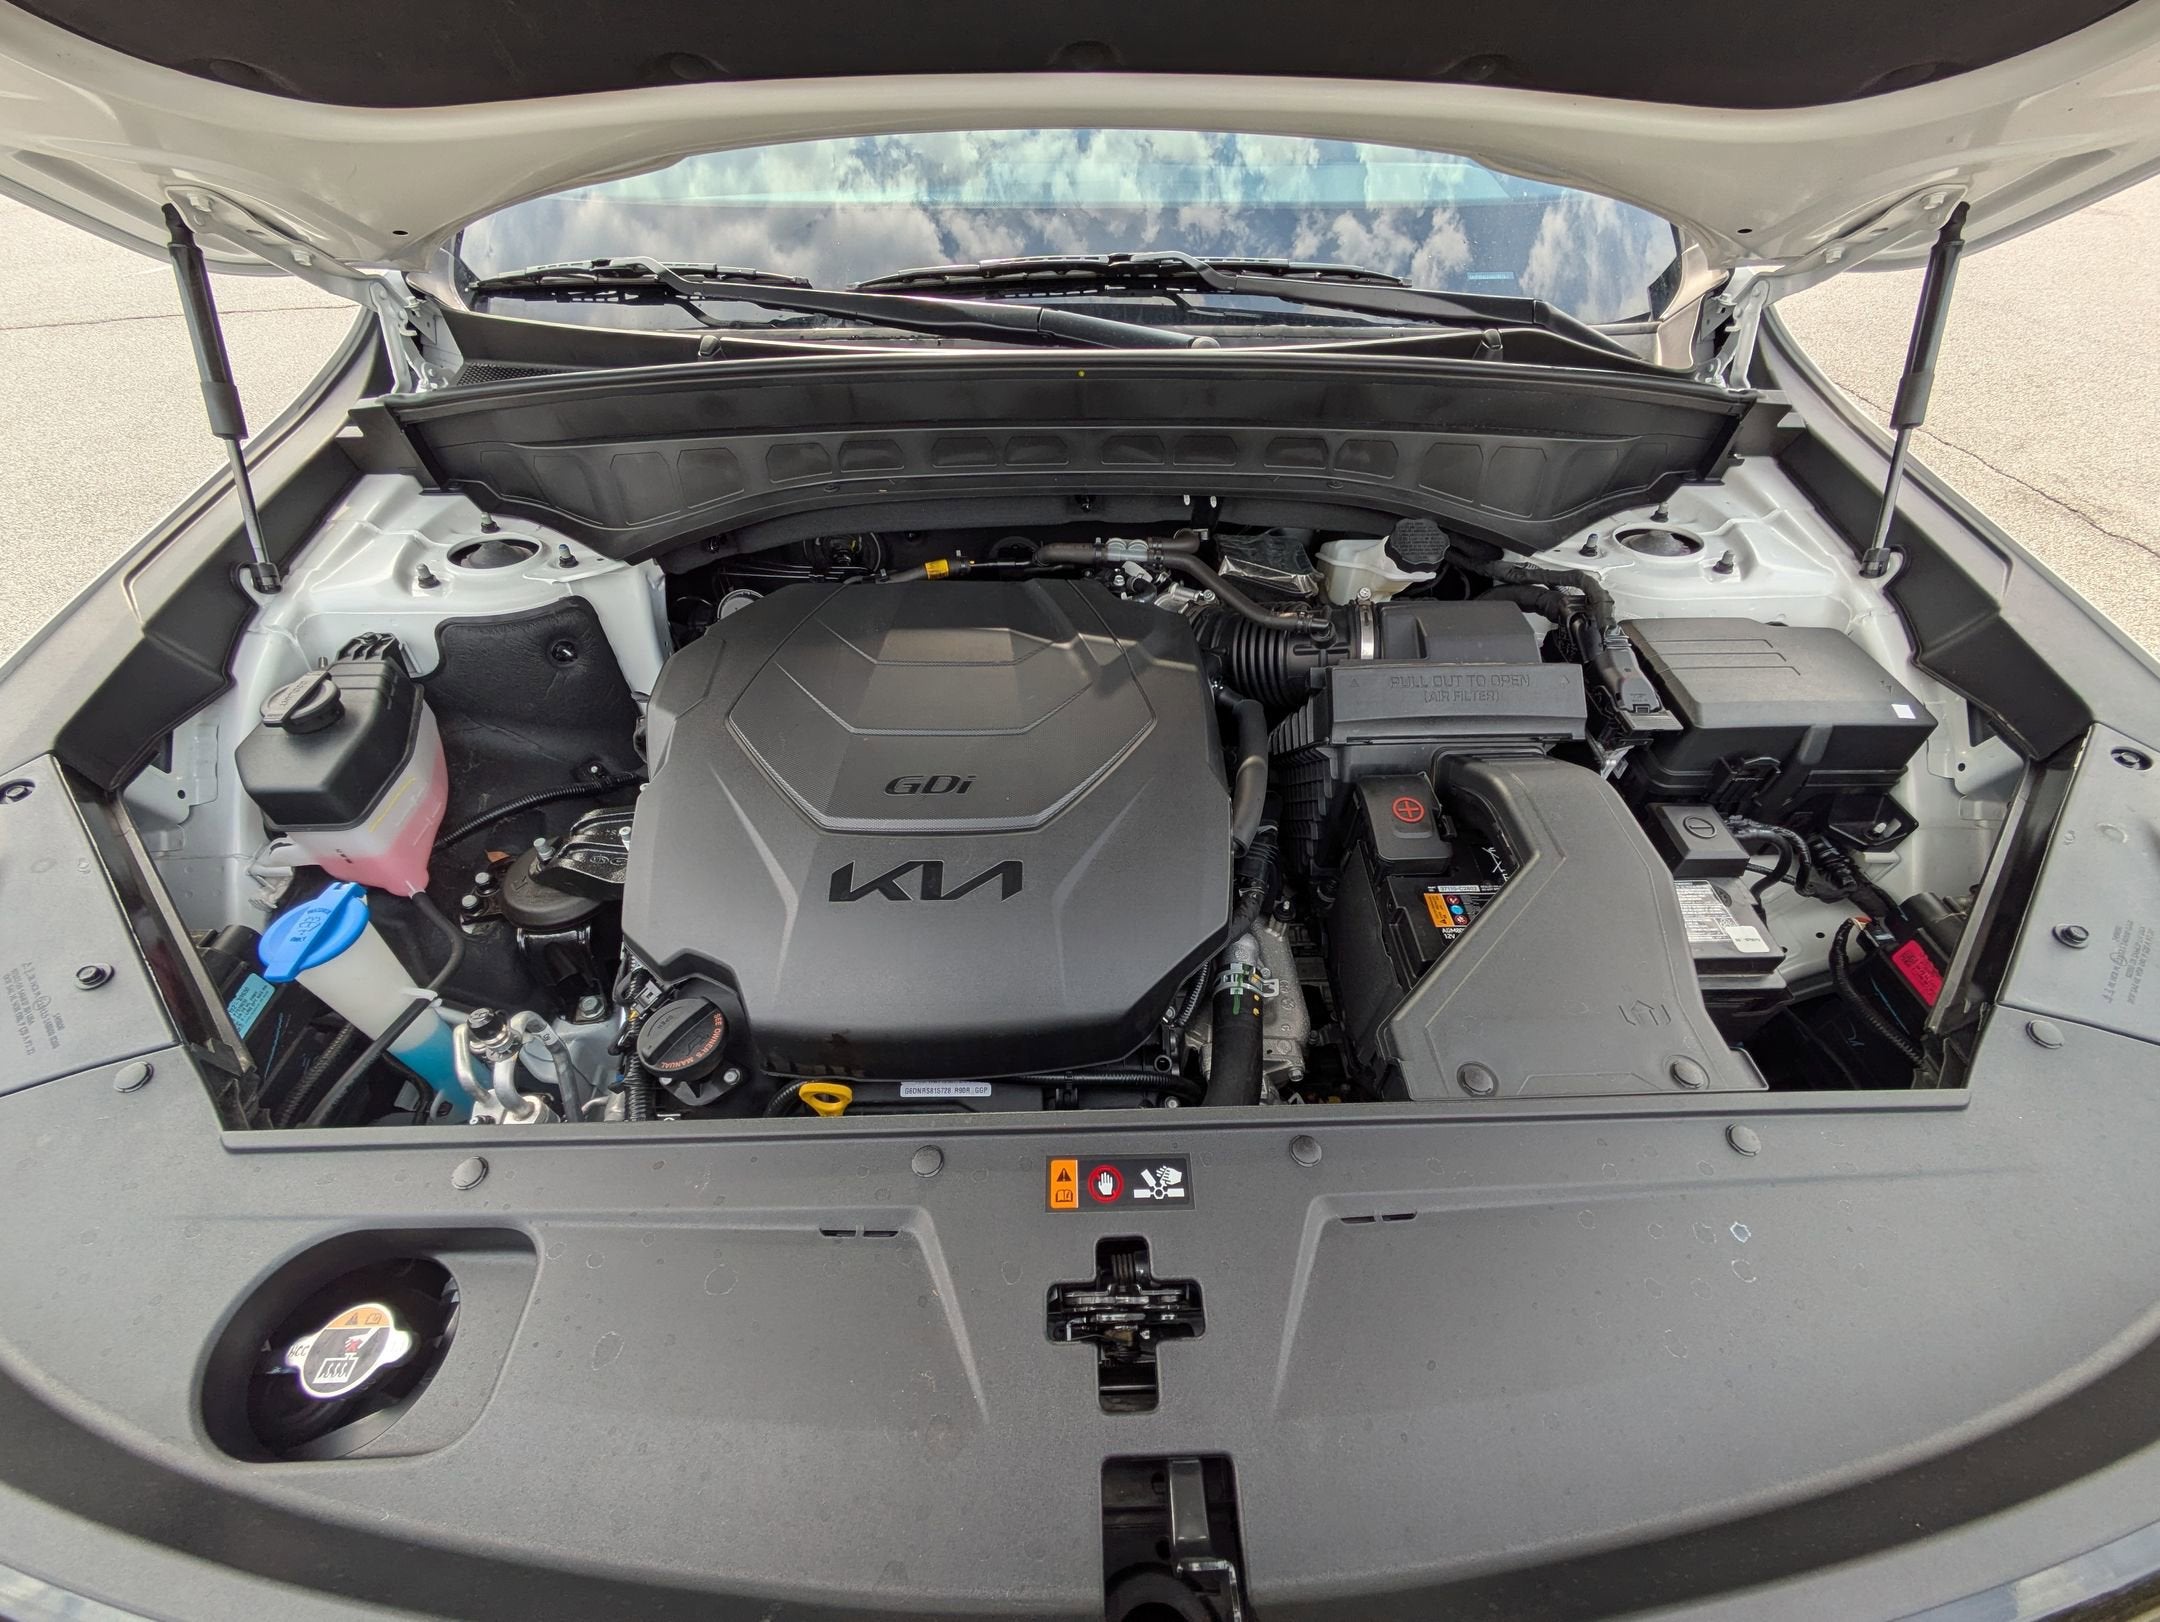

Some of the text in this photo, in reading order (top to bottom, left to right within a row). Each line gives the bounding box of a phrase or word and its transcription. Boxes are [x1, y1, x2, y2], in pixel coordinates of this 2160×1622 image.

[1391, 674, 1530, 688] PULL OUT TO OPEN
[1424, 690, 1500, 703] (AIR FILTER)
[884, 774, 977, 796] GDi
[829, 860, 1024, 903] KIA
[713, 1013, 722, 1026] SEE
[661, 1056, 694, 1069] MANUAL
